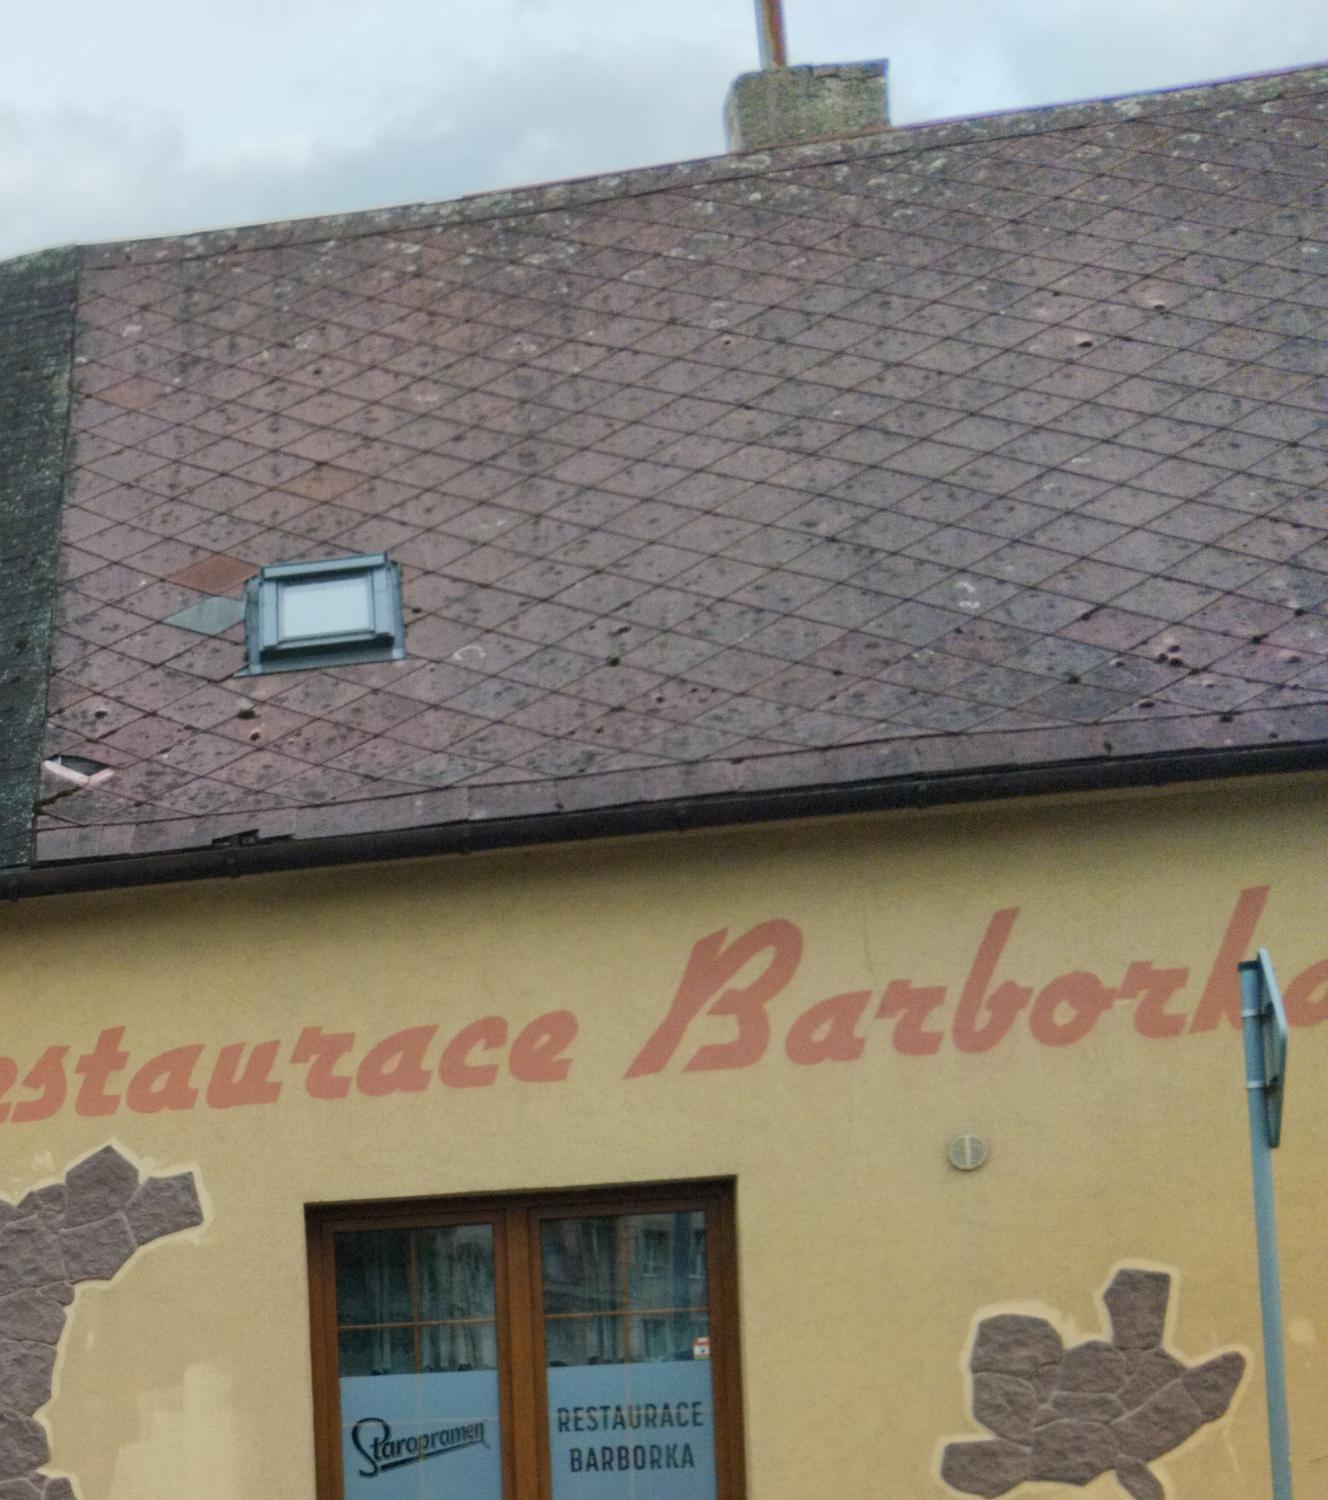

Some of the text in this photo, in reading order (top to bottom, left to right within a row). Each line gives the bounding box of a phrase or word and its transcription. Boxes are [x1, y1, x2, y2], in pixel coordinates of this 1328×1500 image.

[557, 1401, 704, 1433] RESTAURACE
[351, 1416, 490, 1479] Staropramen
[569, 1443, 695, 1473] BARBORKA
